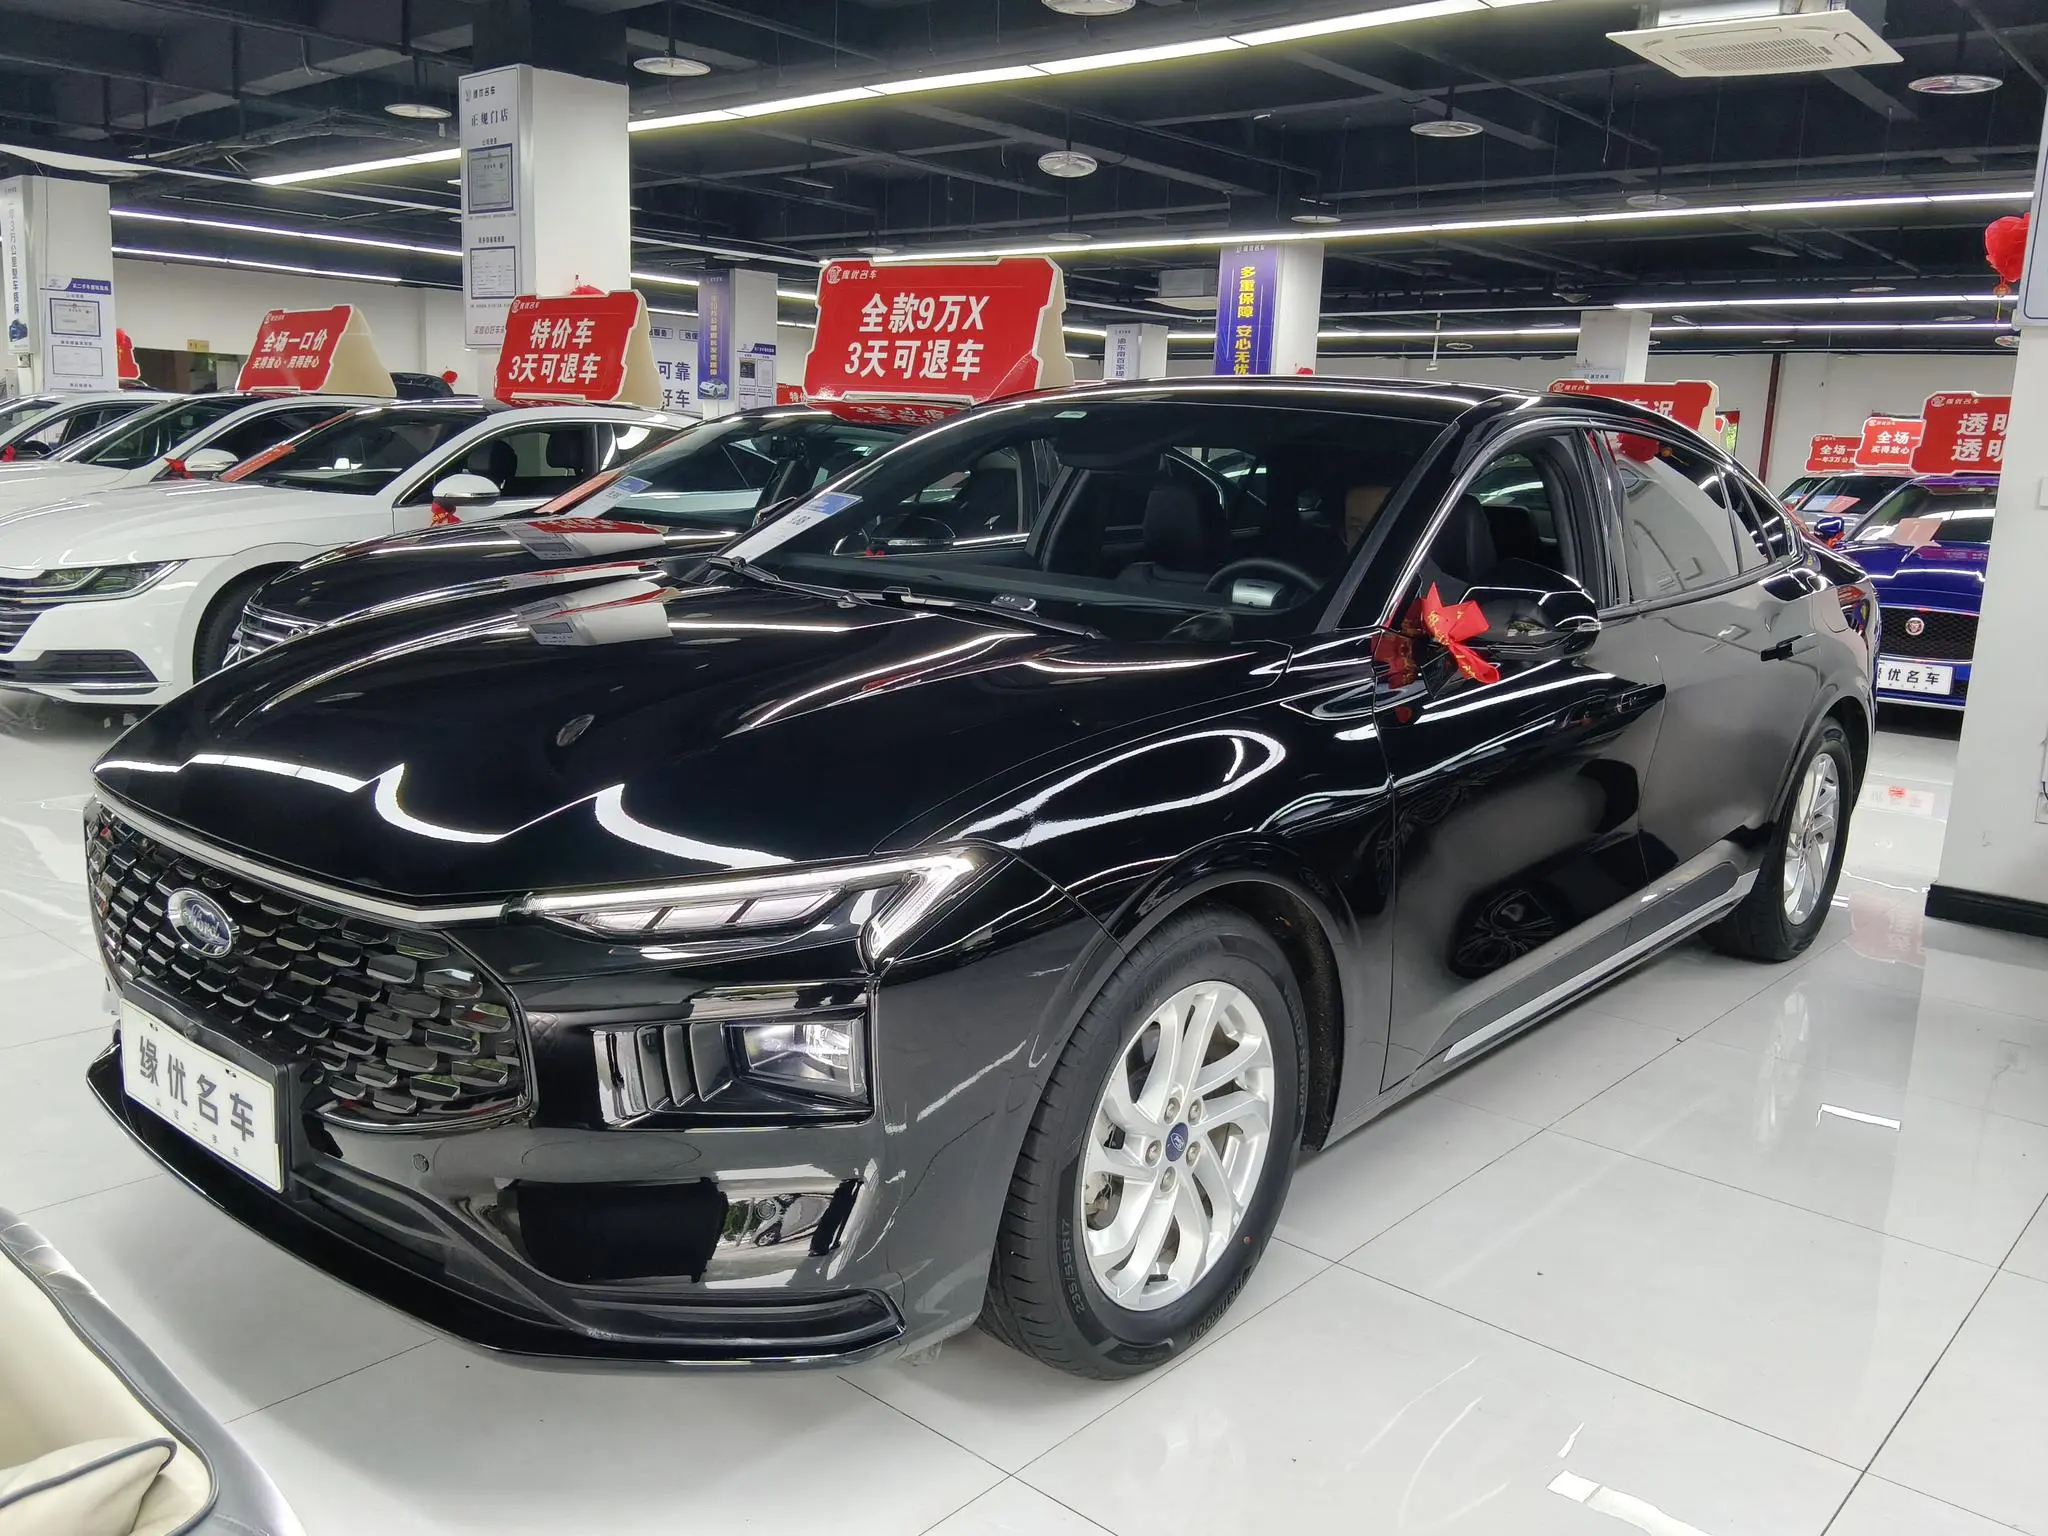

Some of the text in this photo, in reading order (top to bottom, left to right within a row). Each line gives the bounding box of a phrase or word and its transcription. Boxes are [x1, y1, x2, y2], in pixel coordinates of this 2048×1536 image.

[859, 293, 990, 333] 全款9万X
[1234, 266, 1256, 375] 多重保障 安心无忧
[261, 329, 328, 352] 全场一口价
[530, 318, 595, 349] 特价车
[509, 353, 601, 384] 3天可退车
[657, 361, 691, 381] 可靠
[845, 339, 984, 381] 3天可退车
[140, 1034, 255, 1143] 缘优名车
[1061, 1218, 1085, 1314] 235/55R17
